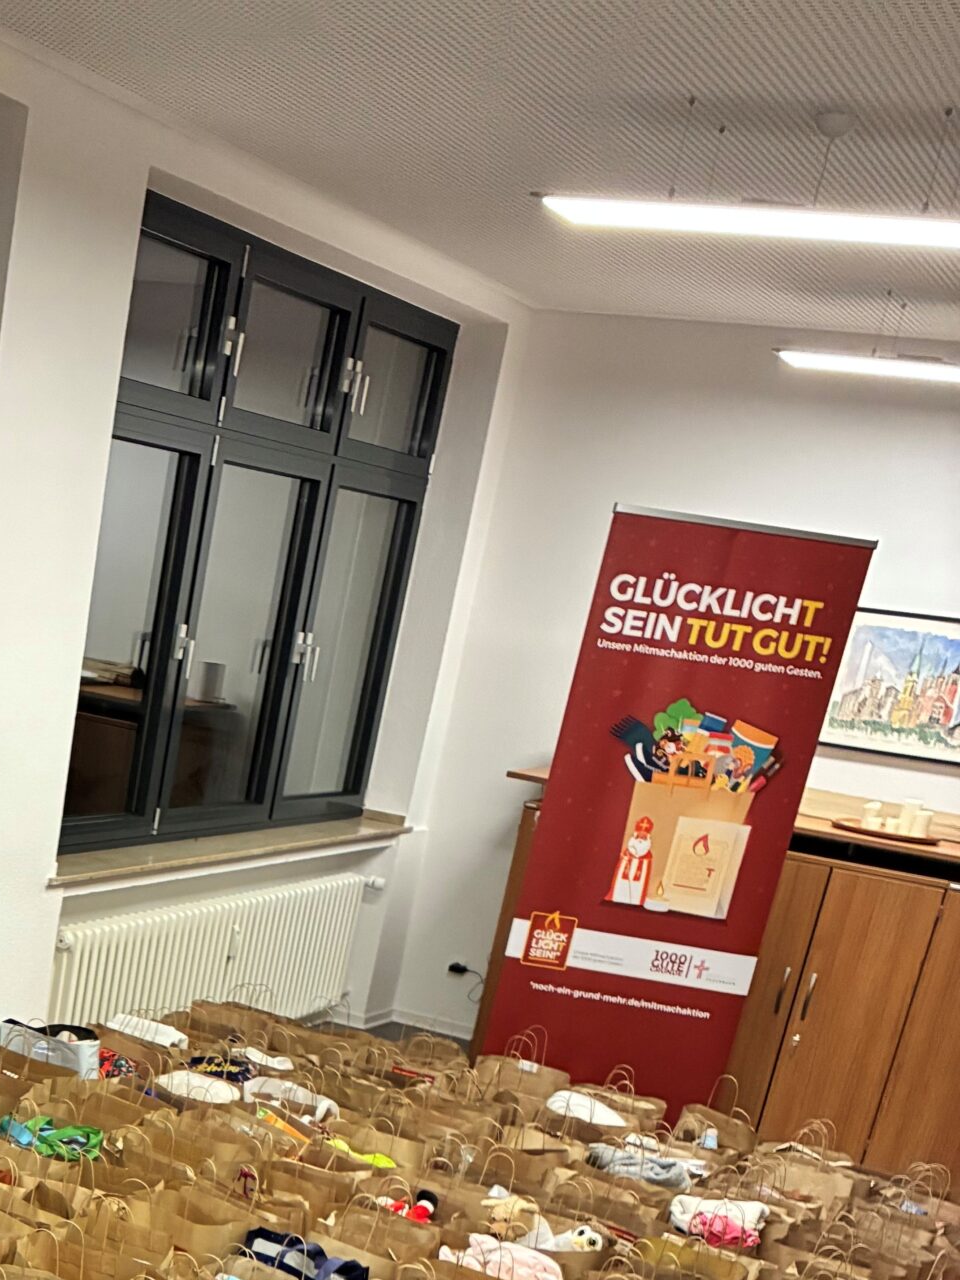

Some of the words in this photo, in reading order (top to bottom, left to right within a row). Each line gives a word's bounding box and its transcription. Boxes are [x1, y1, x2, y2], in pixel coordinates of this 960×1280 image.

[609, 572, 824, 628] GLÜCKLICHT
[600, 606, 683, 643] SEIN
[686, 617, 753, 652] TUT
[752, 628, 832, 664] GUT!
[597, 638, 632, 652] Unsere
[633, 643, 708, 664] Mitmachaktion
[709, 653, 728, 666] der
[728, 656, 754, 669] 1000
[754, 661, 785, 675] guten
[786, 664, 823, 679] Gesten.
[531, 938, 566, 952] LICHT
[533, 929, 568, 942] GLÜCK
[654, 950, 687, 965] 1000
